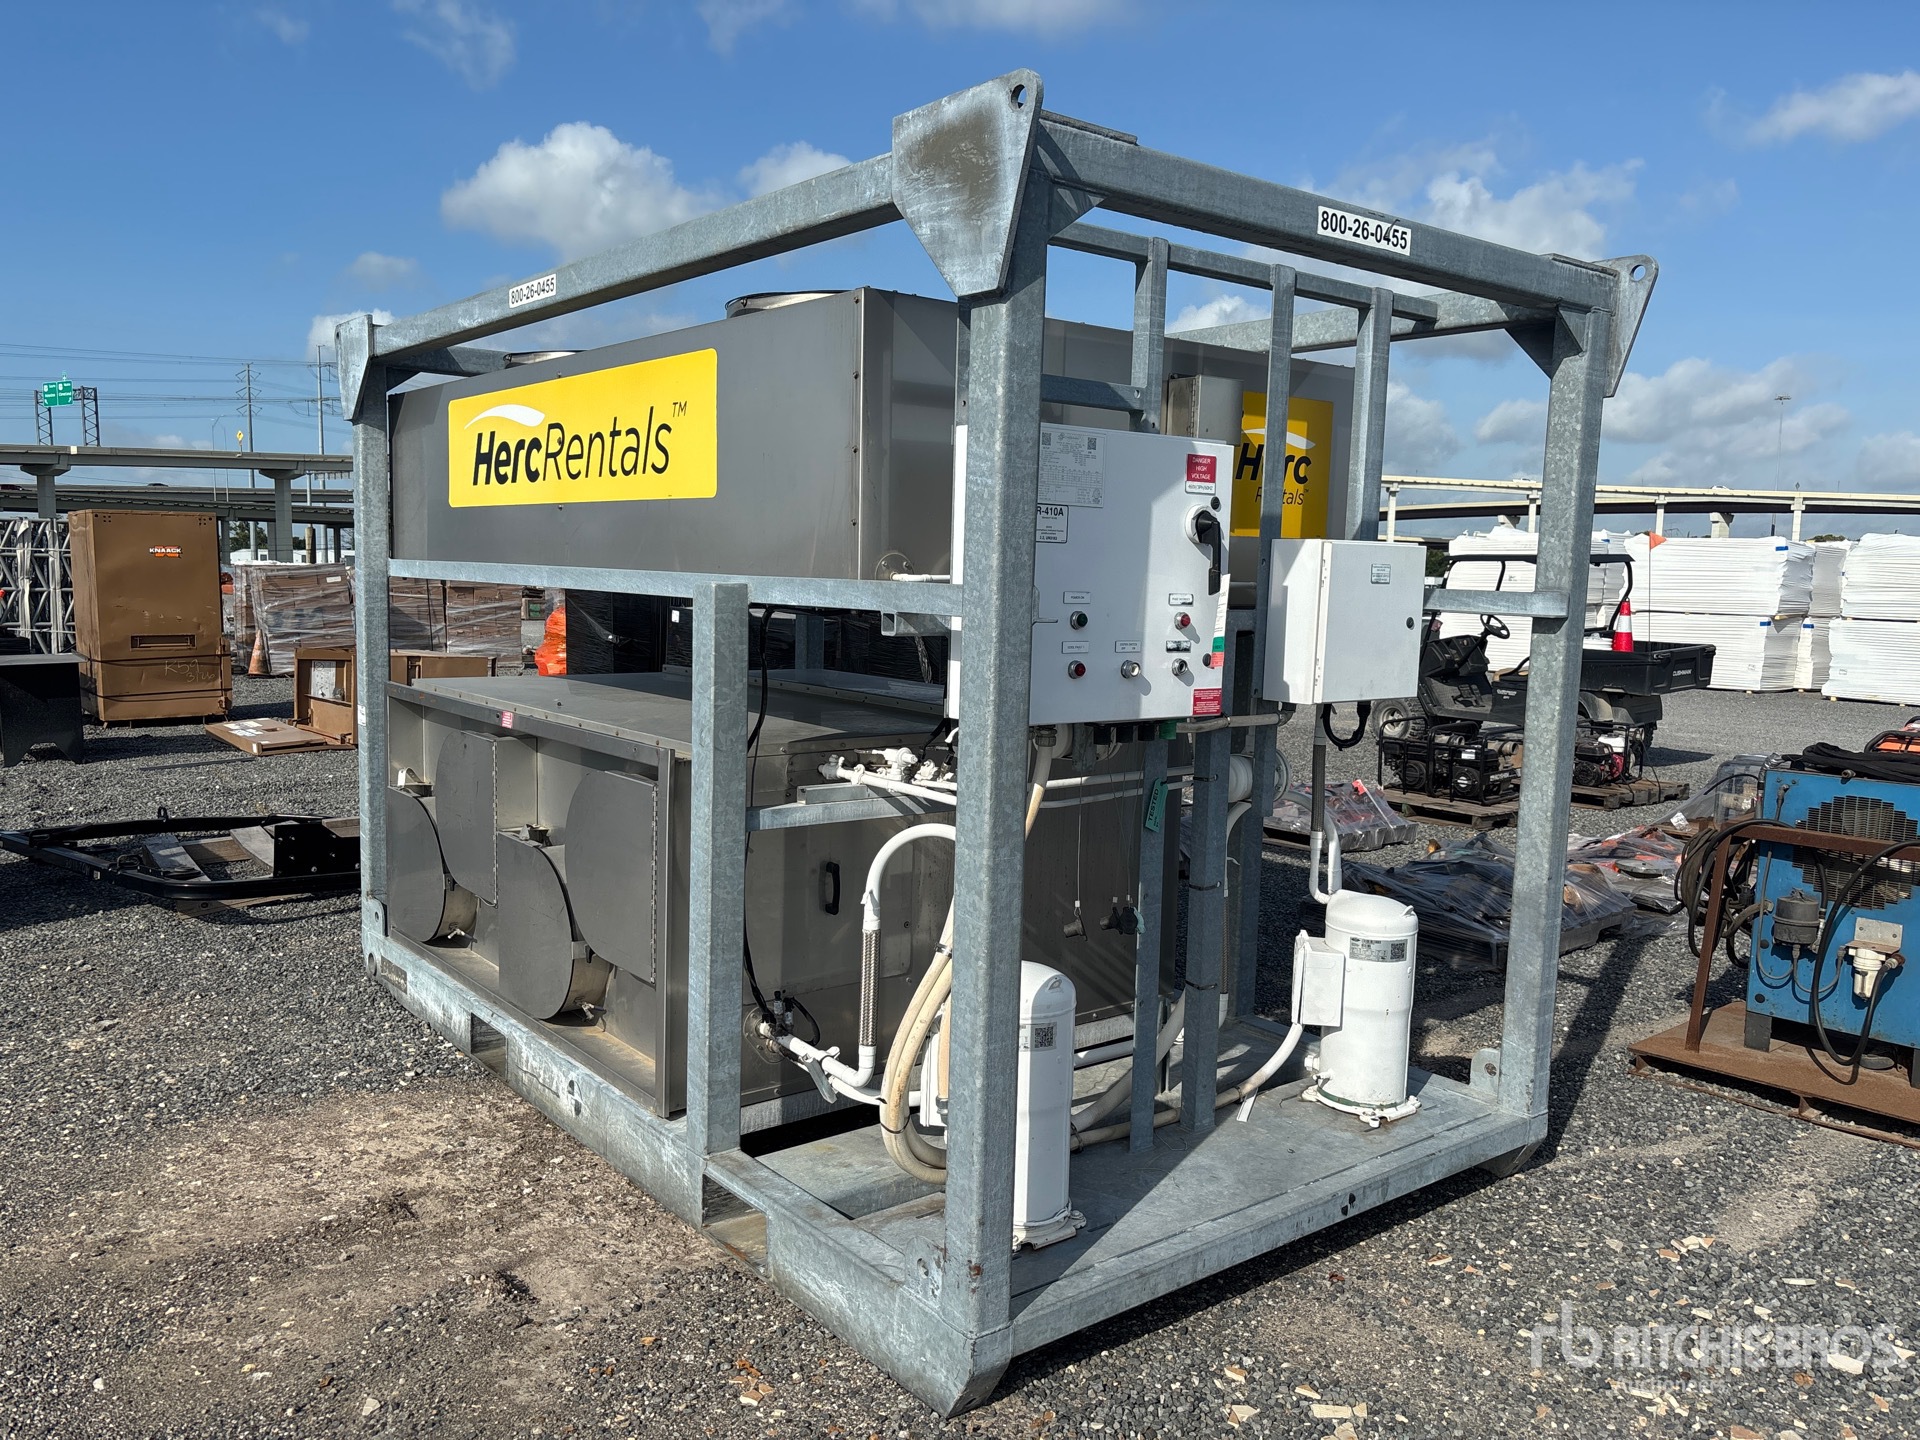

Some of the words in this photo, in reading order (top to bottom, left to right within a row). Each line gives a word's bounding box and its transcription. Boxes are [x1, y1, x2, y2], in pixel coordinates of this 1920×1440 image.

[1320, 210, 1408, 250] 800-26-0455
[510, 277, 555, 305] 800-26-0455
[1235, 443, 1312, 485] Hrc
[1148, 788, 1159, 822] TESTED
